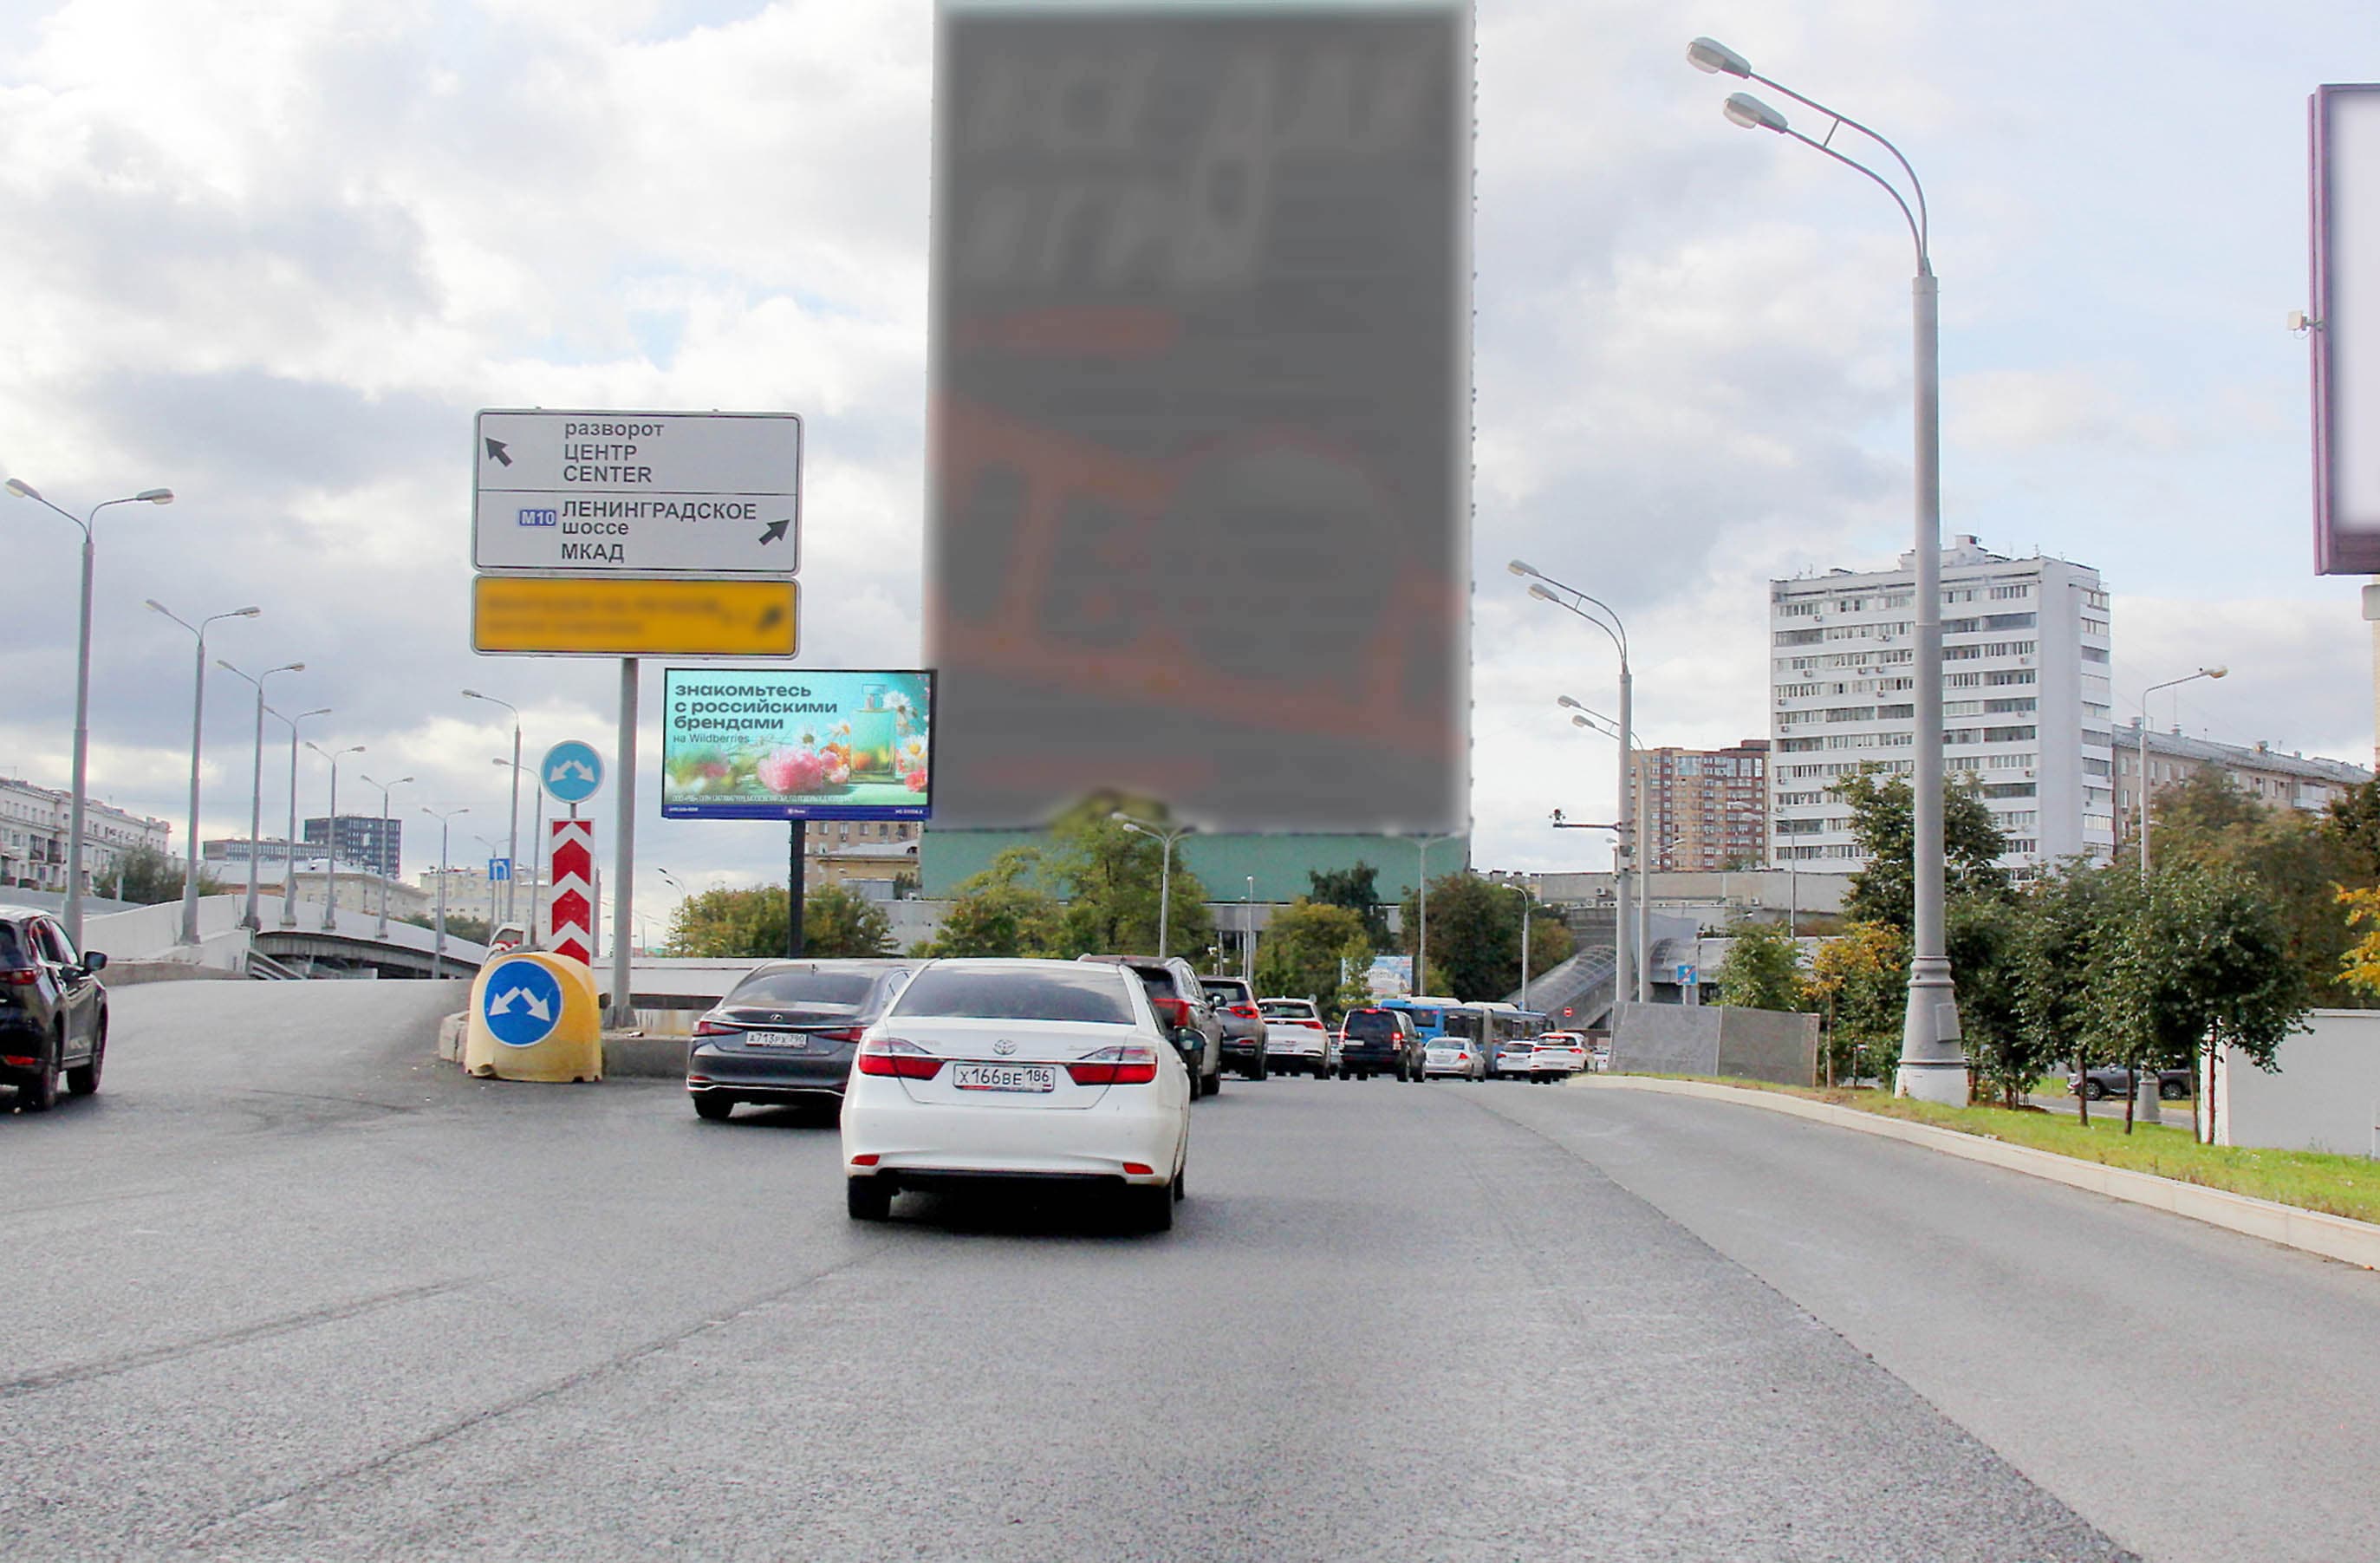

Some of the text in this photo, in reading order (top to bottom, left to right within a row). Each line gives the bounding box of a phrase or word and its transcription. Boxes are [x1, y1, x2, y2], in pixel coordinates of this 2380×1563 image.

[565, 423, 664, 440] разворот
[564, 444, 638, 463] ЦЕНТР
[563, 466, 652, 483] CENTER
[562, 501, 757, 522] ЛЕНИНГРАДСКОЕ
[562, 522, 629, 535] шоссе
[562, 544, 625, 563] МКАД
[674, 685, 812, 697] знакомьтесь
[674, 699, 838, 715] с российскими
[674, 715, 784, 732] брендами
[673, 733, 750, 743] на Wildberries
